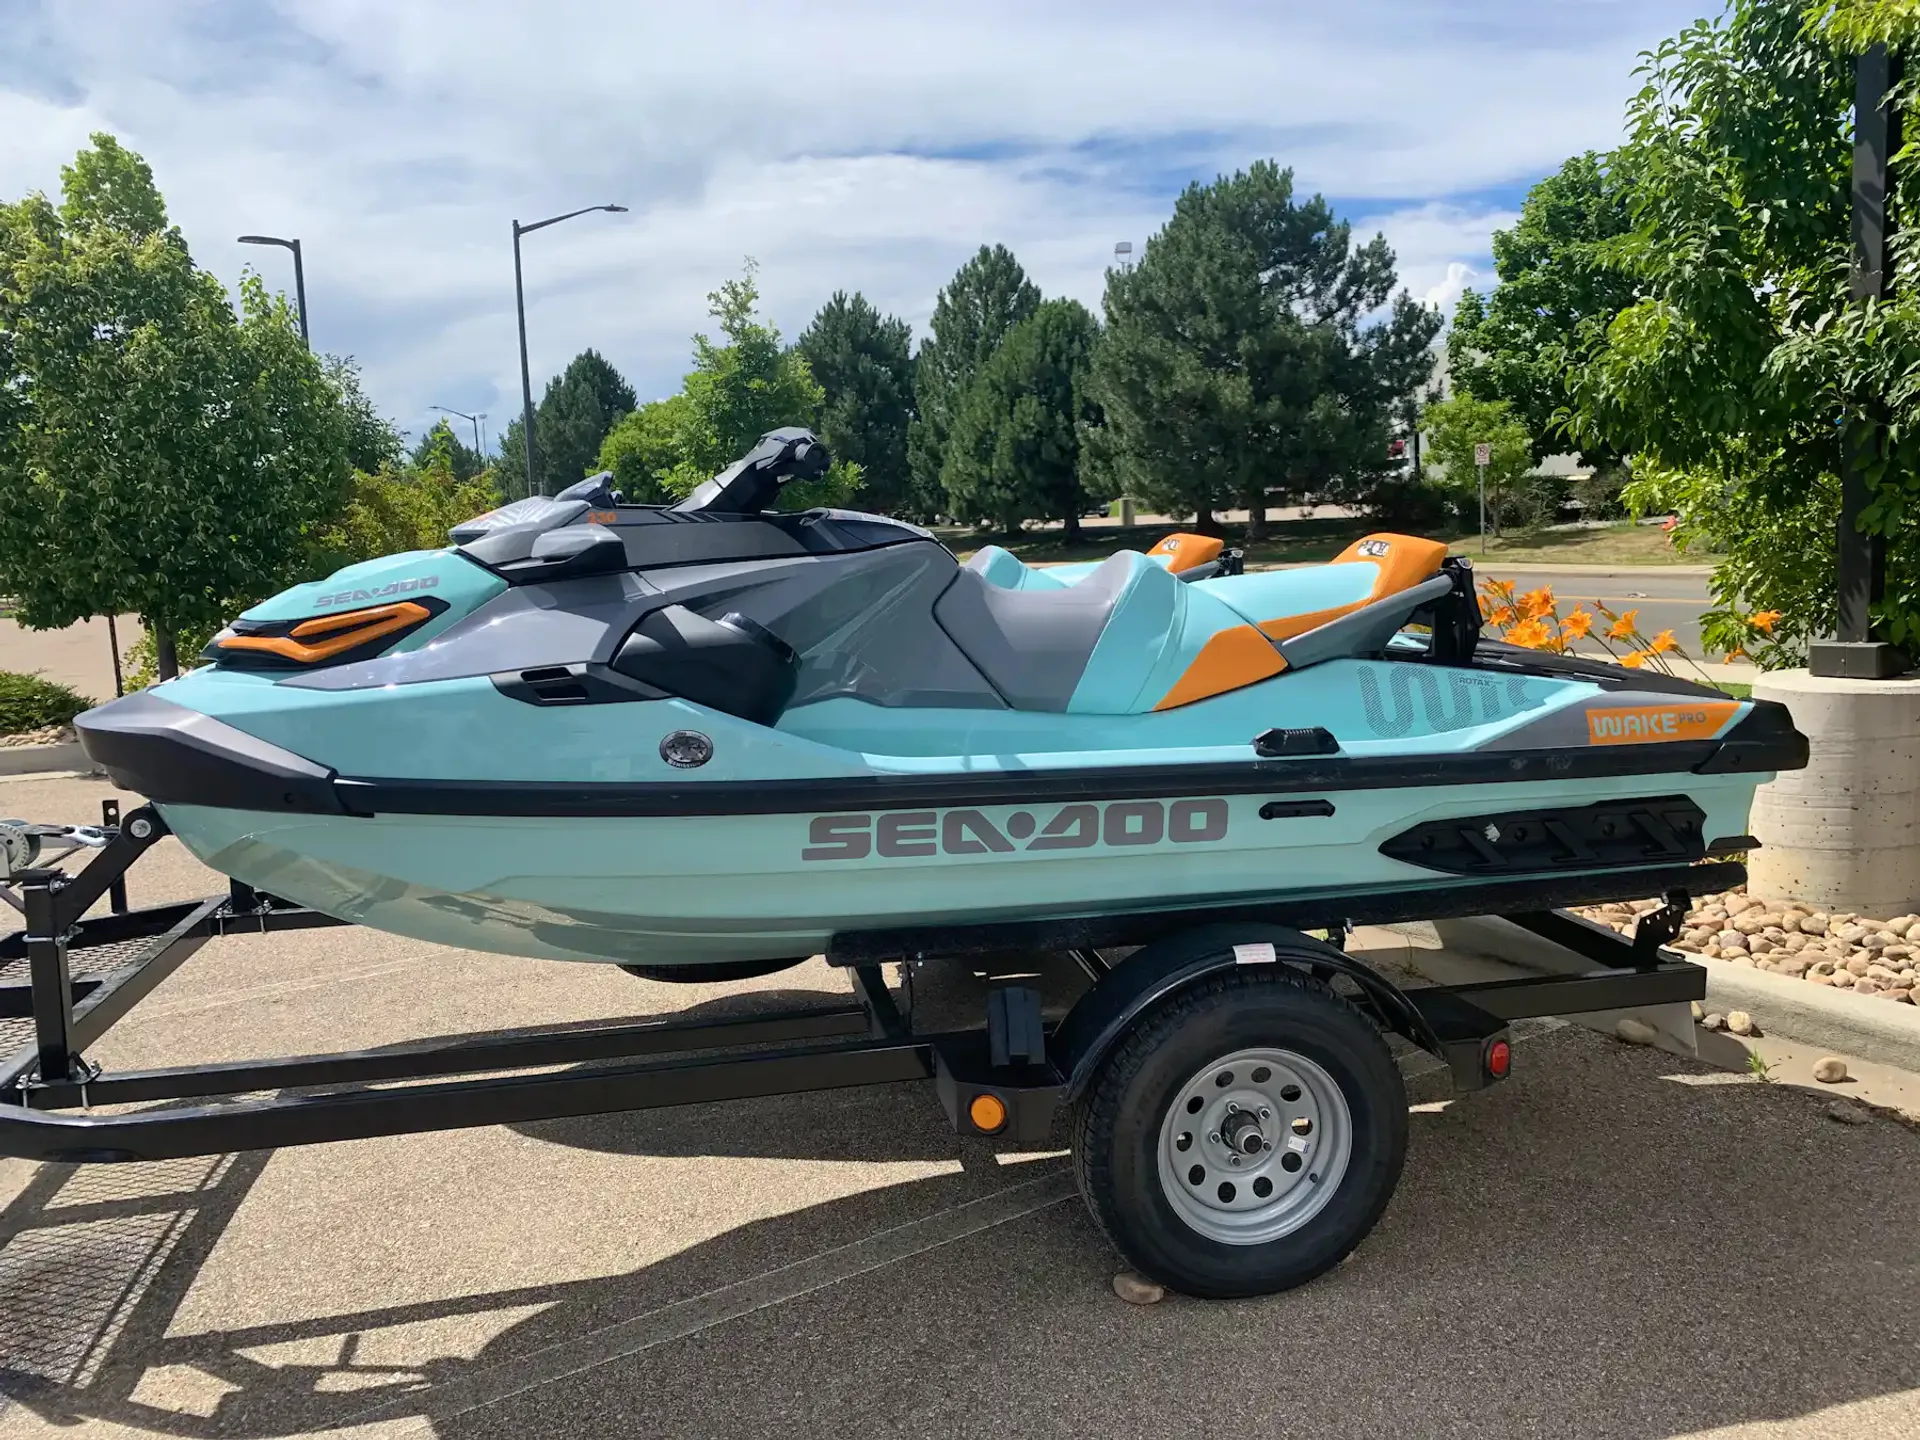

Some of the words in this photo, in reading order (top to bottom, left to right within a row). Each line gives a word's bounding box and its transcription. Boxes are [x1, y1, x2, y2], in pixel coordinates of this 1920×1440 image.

[1459, 677, 1491, 687] ROTAX
[1593, 712, 1678, 738] WAKE
[1679, 711, 1706, 724] PRO
